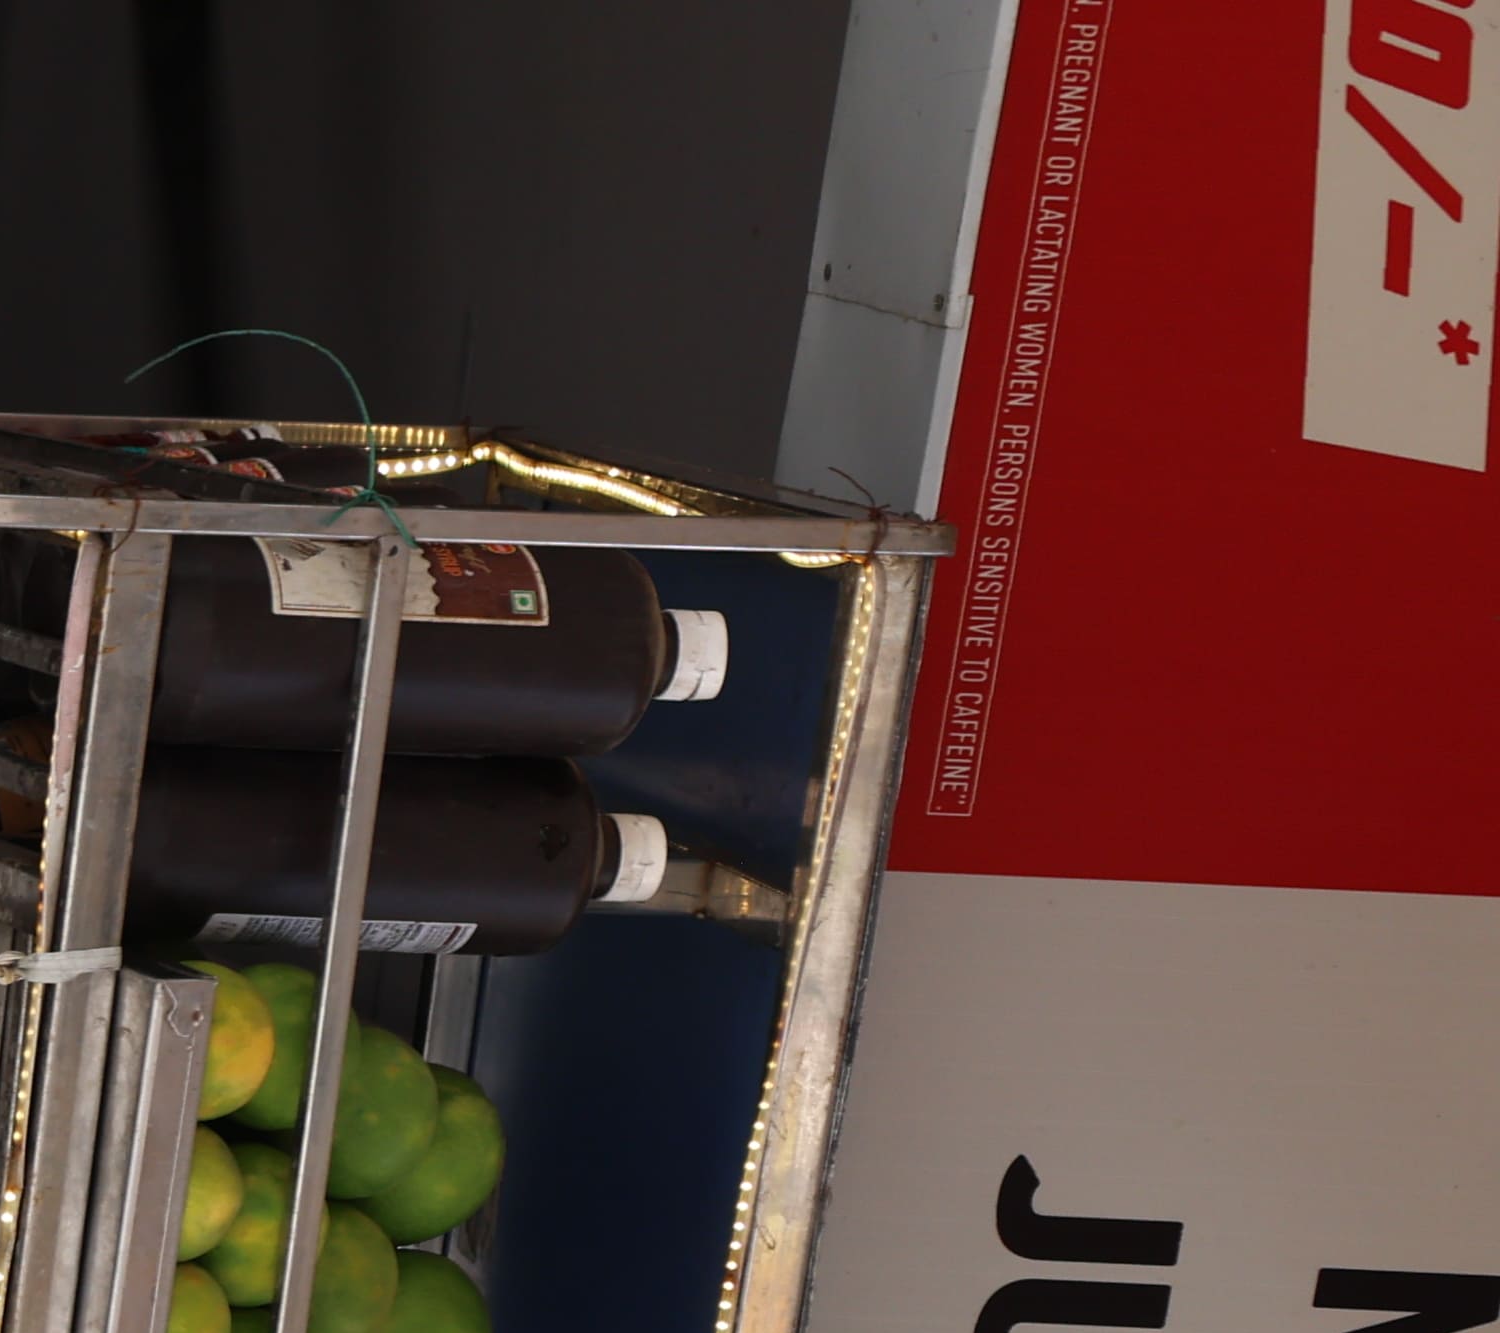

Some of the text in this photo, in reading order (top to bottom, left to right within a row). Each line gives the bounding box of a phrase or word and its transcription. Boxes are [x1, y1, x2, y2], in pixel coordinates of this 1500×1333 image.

[1051, 24, 1099, 146] PREGNANT
[1043, 156, 1075, 185] OR
[1023, 195, 1068, 312] LACTATING
[985, 425, 1030, 526] PERSONS
[964, 537, 1010, 647] SENSITIVE
[960, 658, 990, 683] TO
